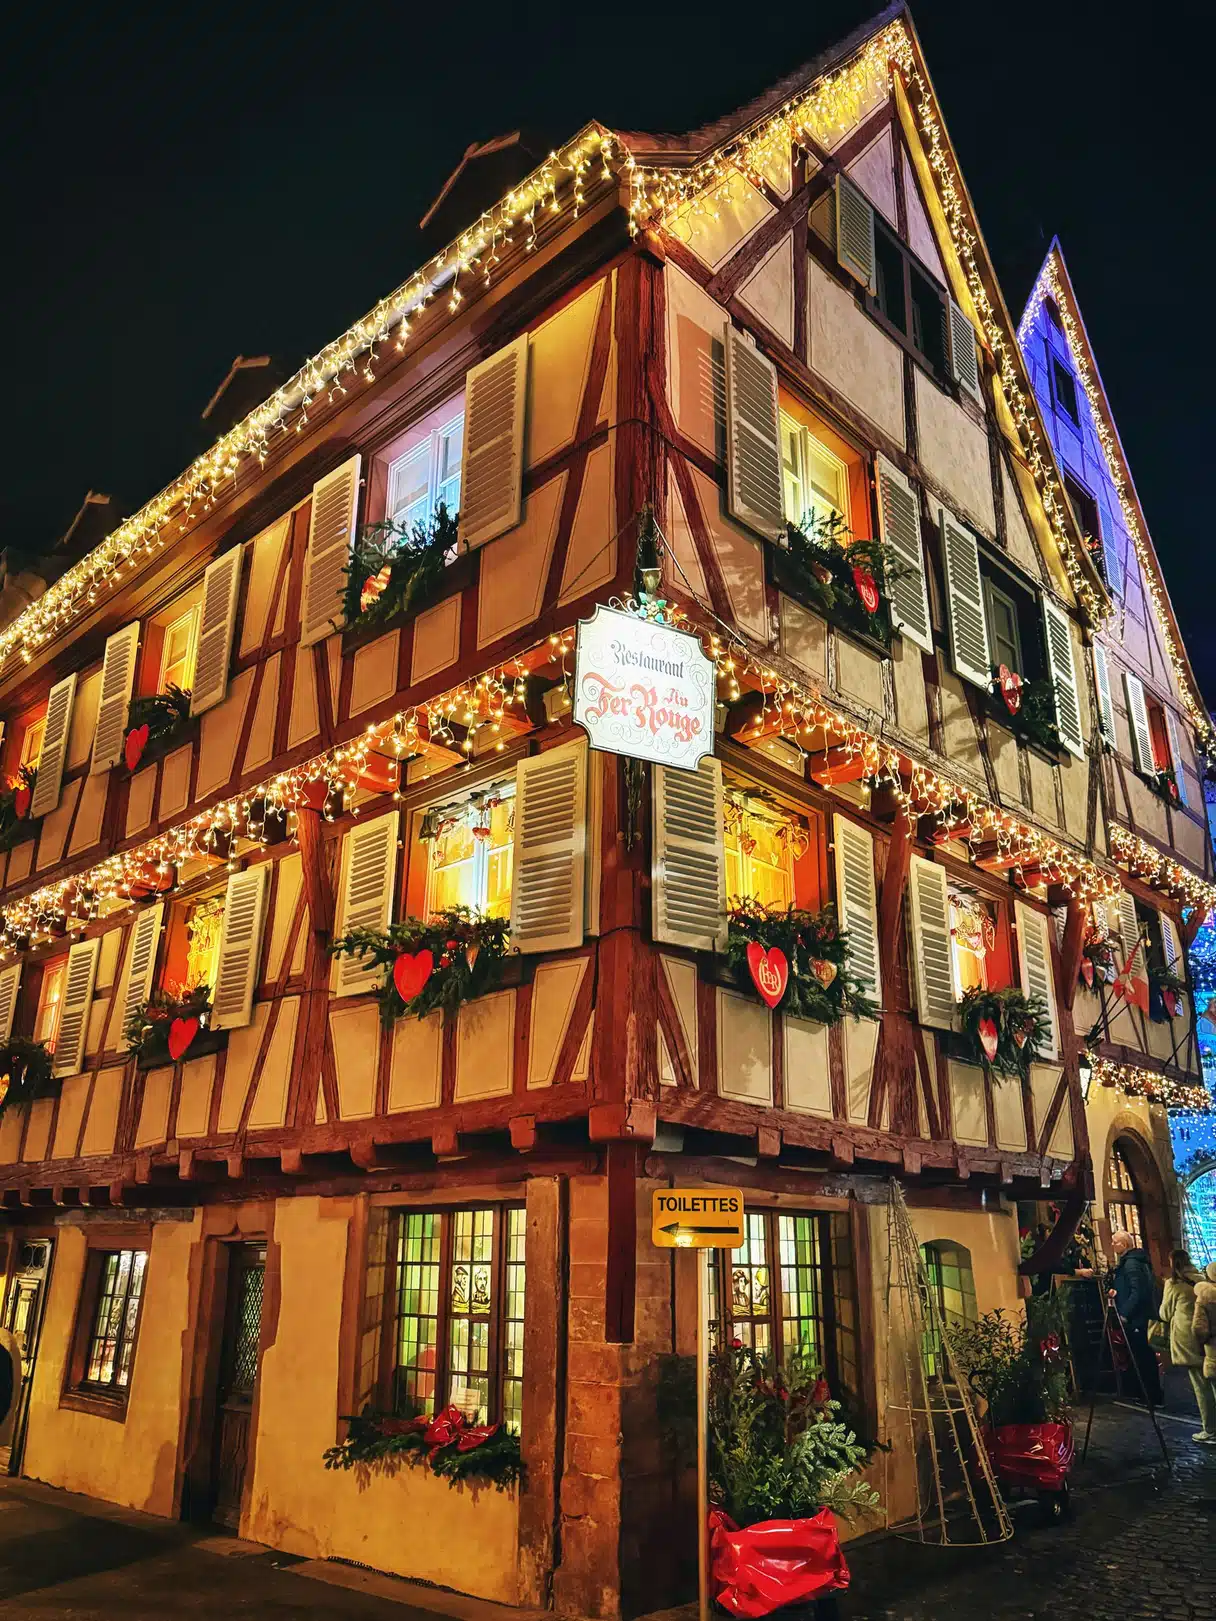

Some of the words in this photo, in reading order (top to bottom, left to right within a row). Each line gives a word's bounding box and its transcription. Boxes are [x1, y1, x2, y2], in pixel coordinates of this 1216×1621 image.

[611, 640, 684, 679] Restaurant
[583, 671, 632, 721] Fer
[630, 683, 701, 742] Rouge
[664, 687, 689, 707] Au
[657, 1196, 739, 1213] TOILETTES
